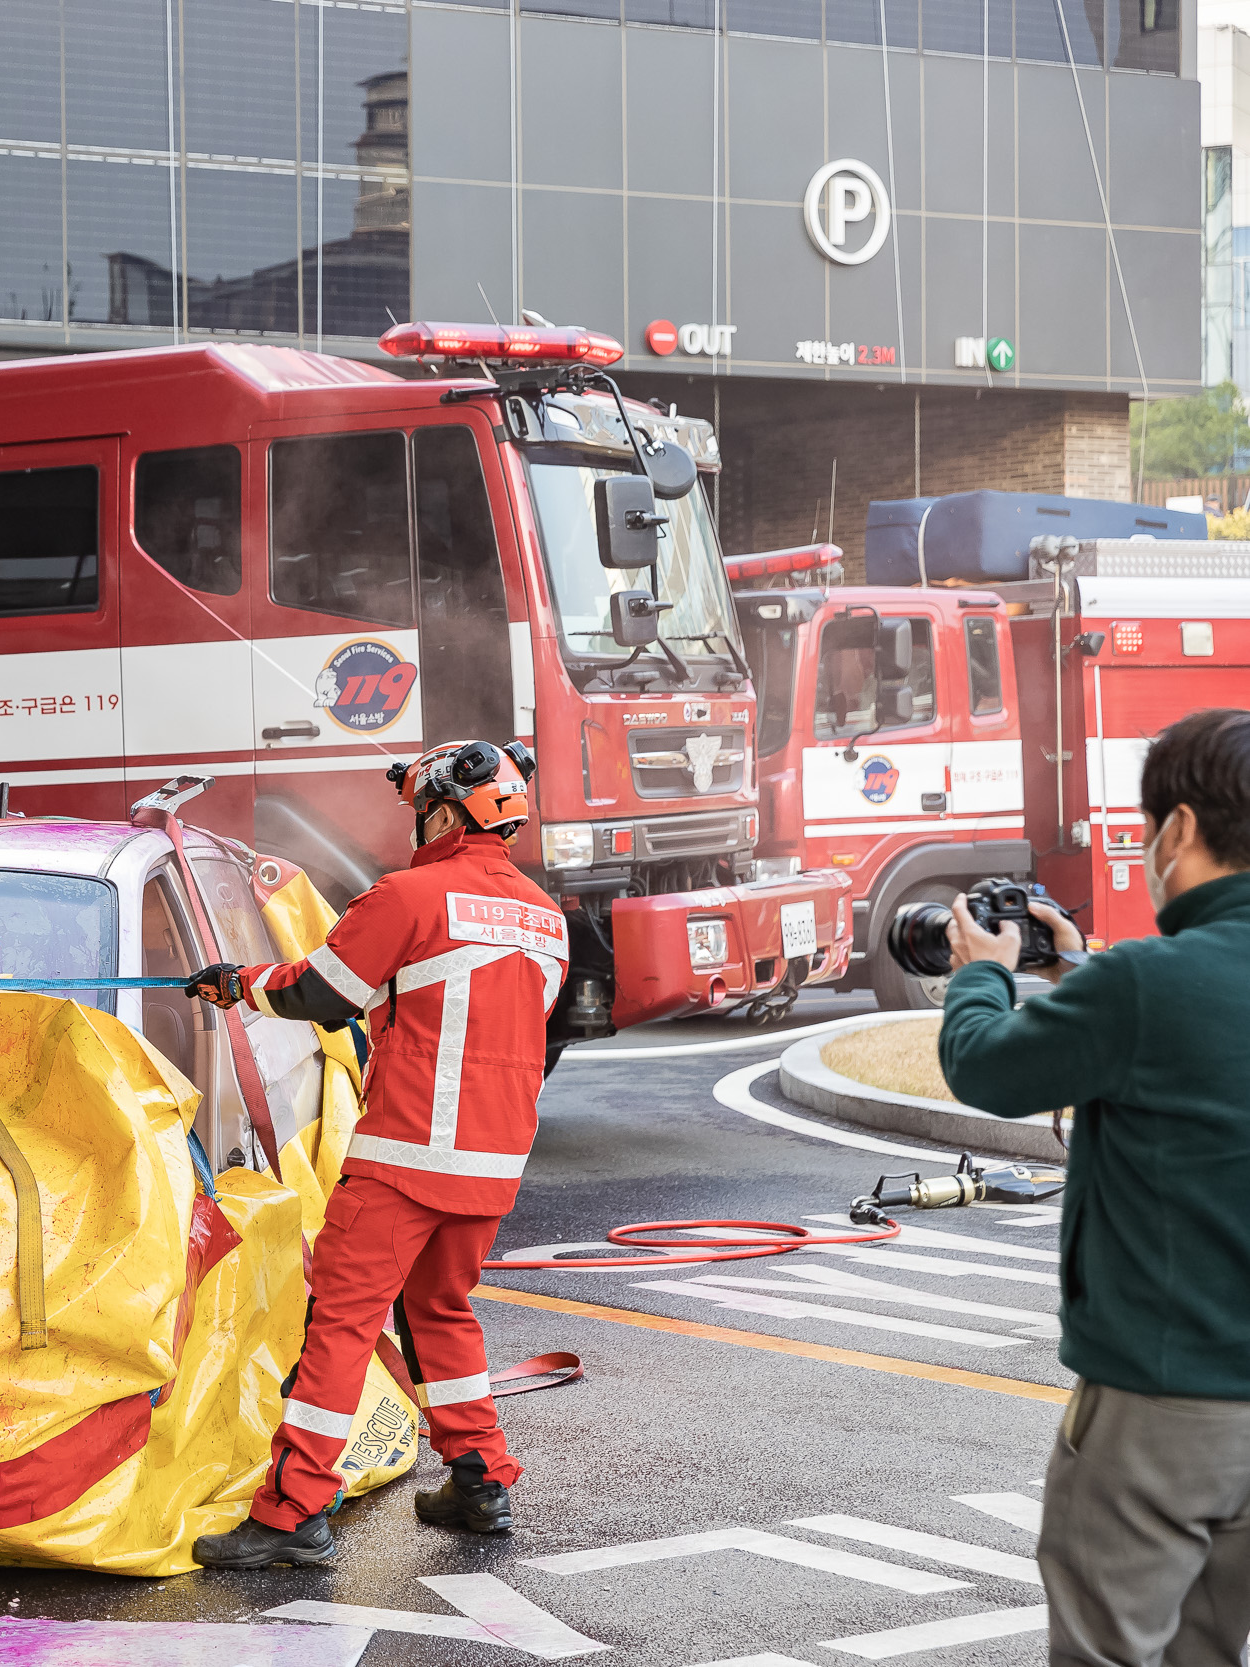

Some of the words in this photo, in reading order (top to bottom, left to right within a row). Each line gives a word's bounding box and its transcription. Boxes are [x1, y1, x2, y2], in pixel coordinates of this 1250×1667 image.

[828, 176, 872, 246] P
[678, 323, 738, 356] OUT
[796, 340, 855, 366] 제한높이
[857, 344, 895, 365] 2.3M
[954, 336, 986, 368] IN
[351, 645, 365, 656] Fire
[366, 643, 395, 664] Services
[336, 662, 418, 711] 119
[84, 694, 119, 712] 119
[350, 711, 385, 726] 서울소방
[623, 712, 668, 726] DAEWOO
[864, 768, 900, 795] 119
[467, 903, 557, 935] 119구조대
